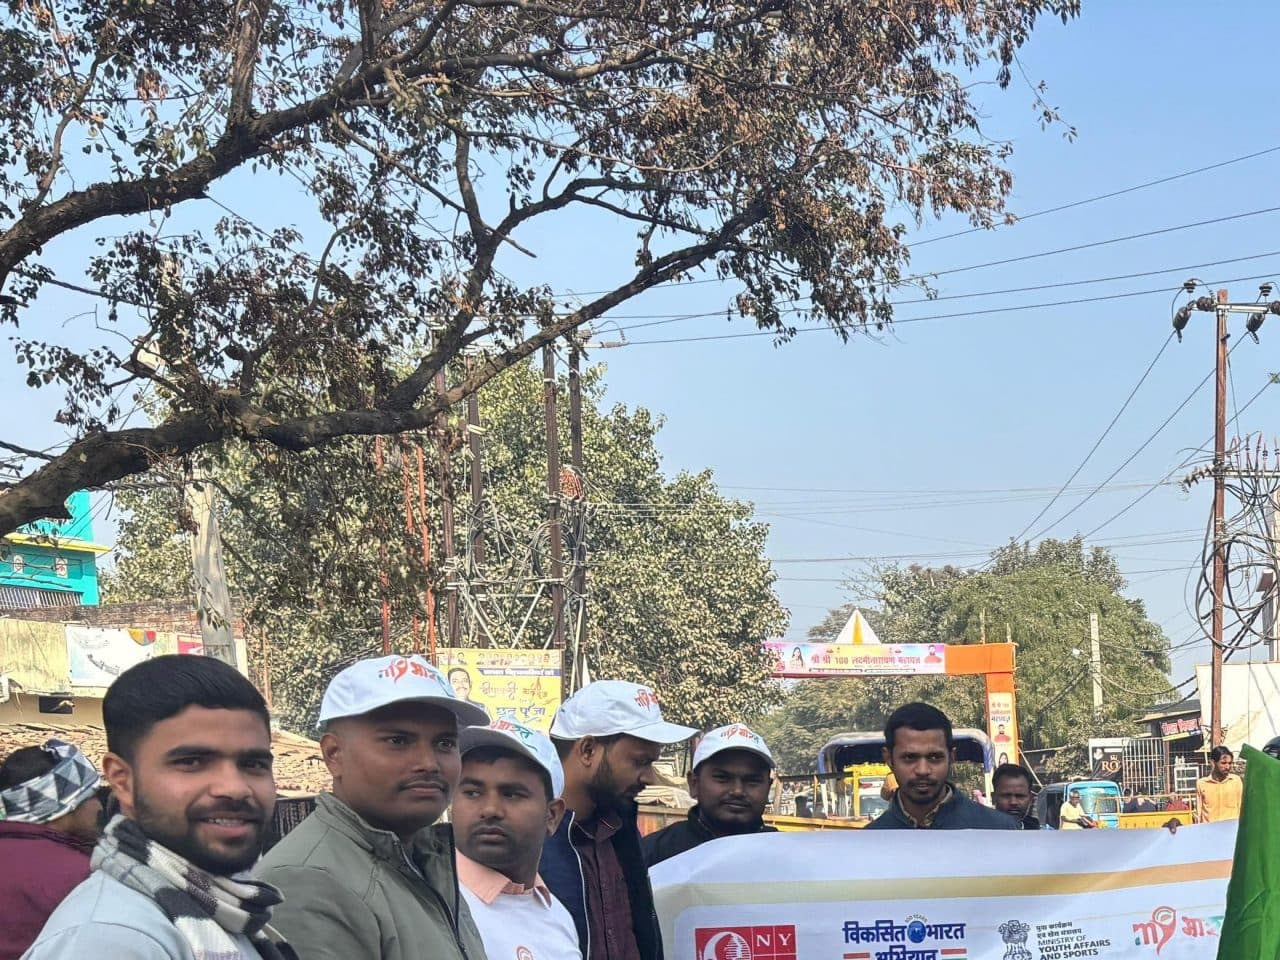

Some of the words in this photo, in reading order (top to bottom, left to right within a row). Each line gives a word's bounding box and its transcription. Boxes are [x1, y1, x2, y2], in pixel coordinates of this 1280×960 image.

[842, 919, 907, 944] विकसित
[926, 923, 966, 940] भारत
[1038, 936, 1074, 946] MINISTRY
[1038, 944, 1071, 953] YOUTH
[1073, 939, 1111, 950] AFFAIRS
[1040, 953, 1061, 960] AND
[1063, 948, 1099, 959] SPORTS
